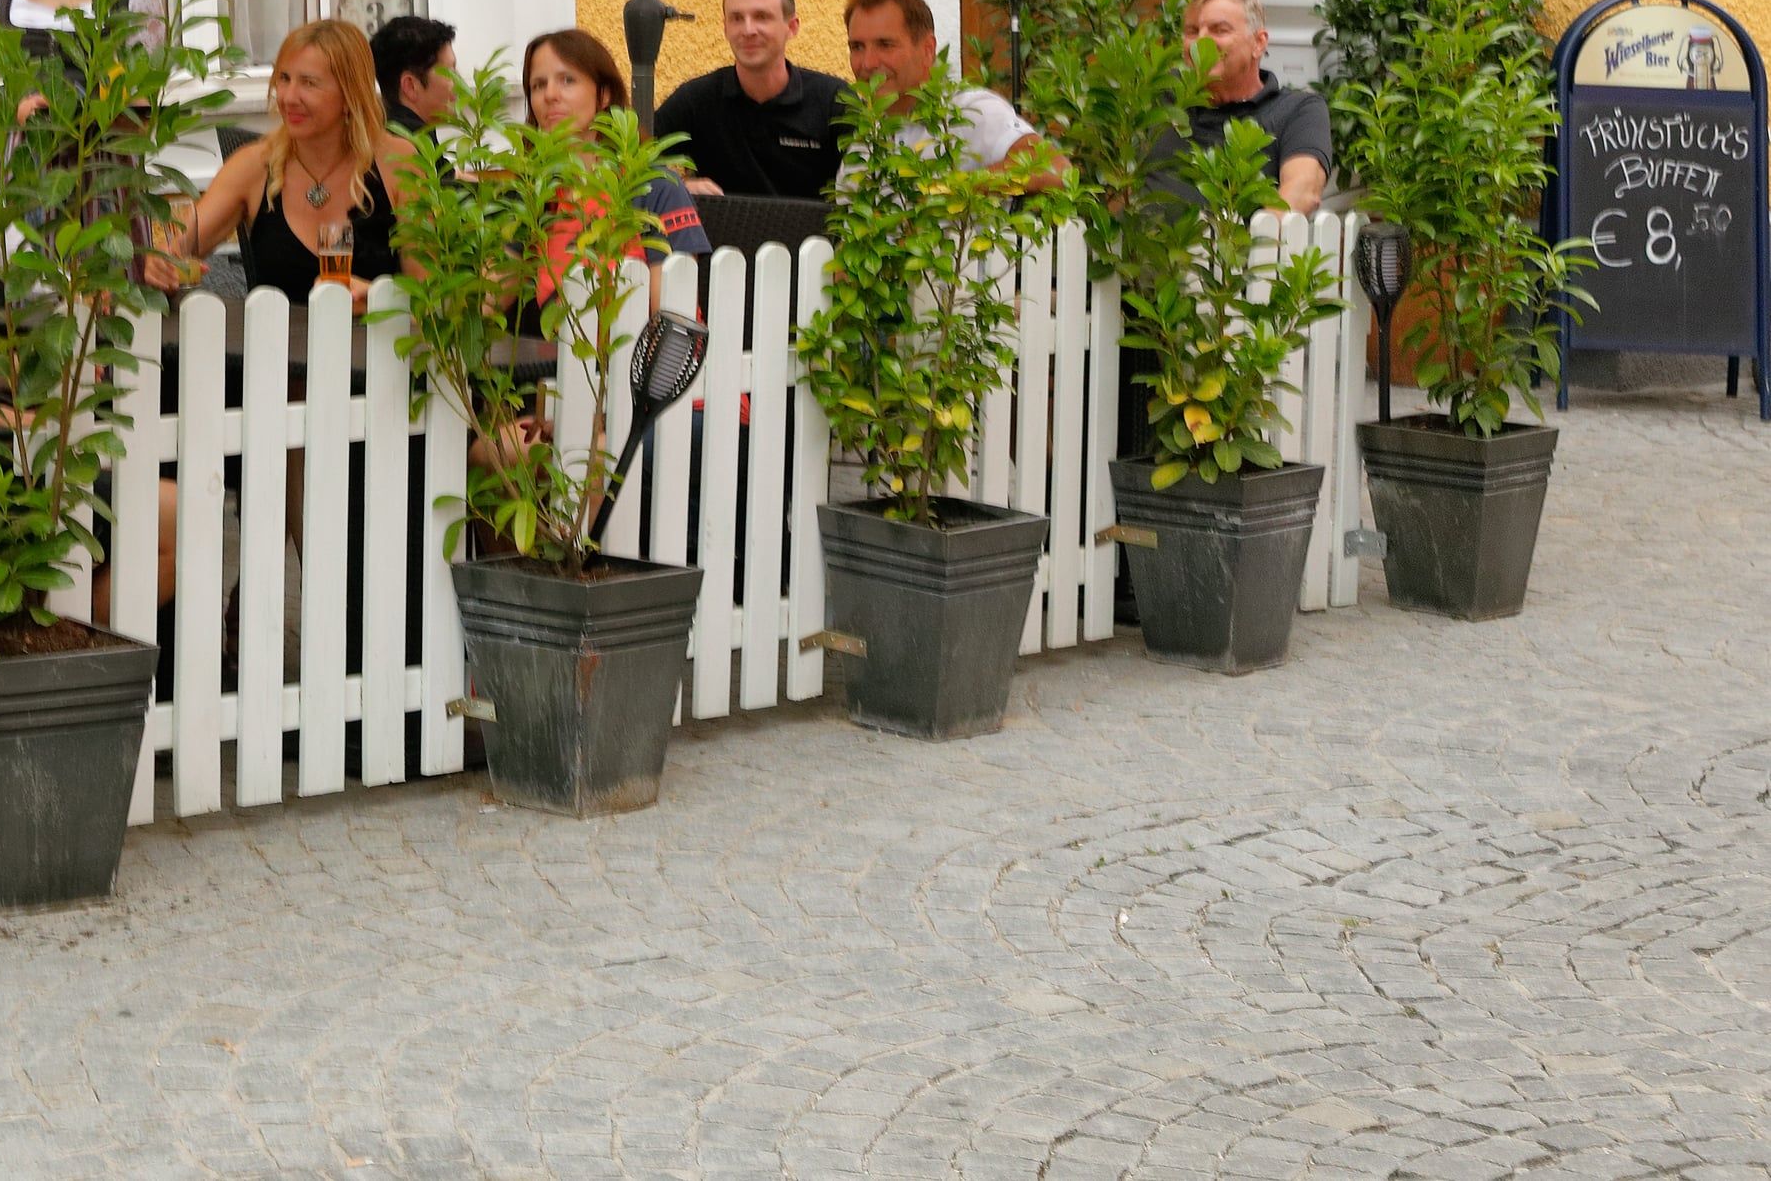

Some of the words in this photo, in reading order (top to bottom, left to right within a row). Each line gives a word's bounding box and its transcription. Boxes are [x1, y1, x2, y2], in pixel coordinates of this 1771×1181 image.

[1604, 30, 1675, 81] Wieselburger
[1645, 50, 1670, 68] Bier
[1579, 107, 1750, 161] FRÜHSTÜCKS
[1591, 207, 1633, 268] €
